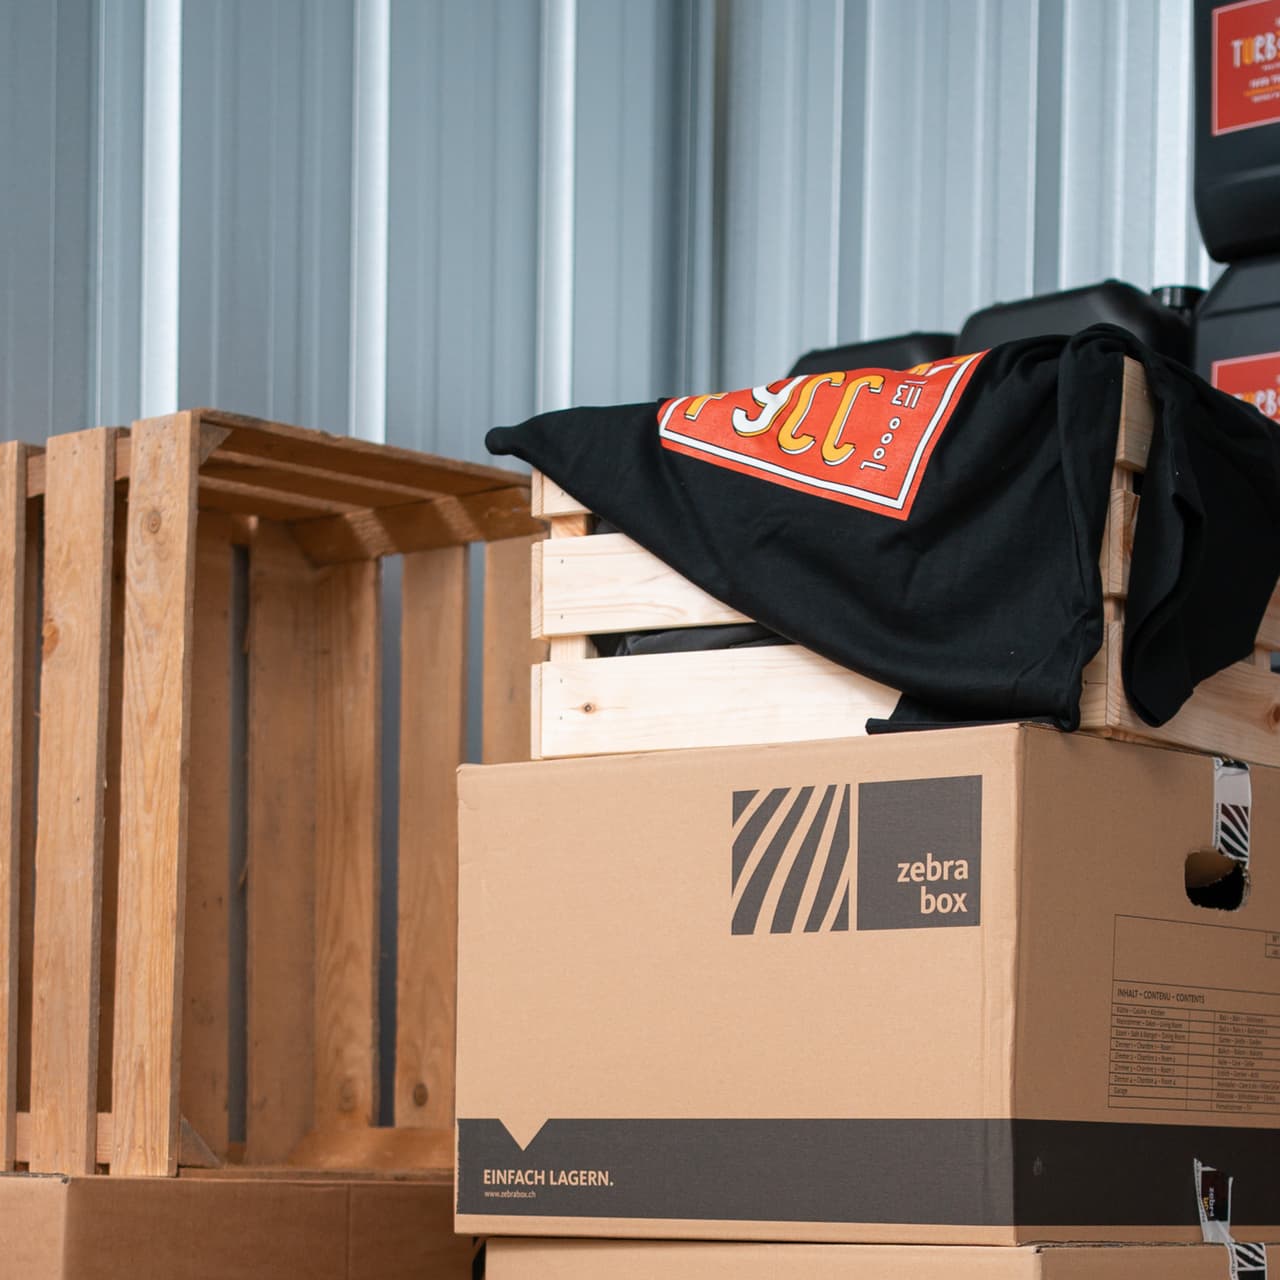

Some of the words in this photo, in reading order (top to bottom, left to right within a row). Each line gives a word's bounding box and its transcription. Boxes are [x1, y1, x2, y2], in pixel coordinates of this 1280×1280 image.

[897, 852, 969, 883] zebra
[920, 885, 968, 914] box
[483, 1169, 545, 1185] EINFACH
[549, 1170, 614, 1186] LAGERN.
